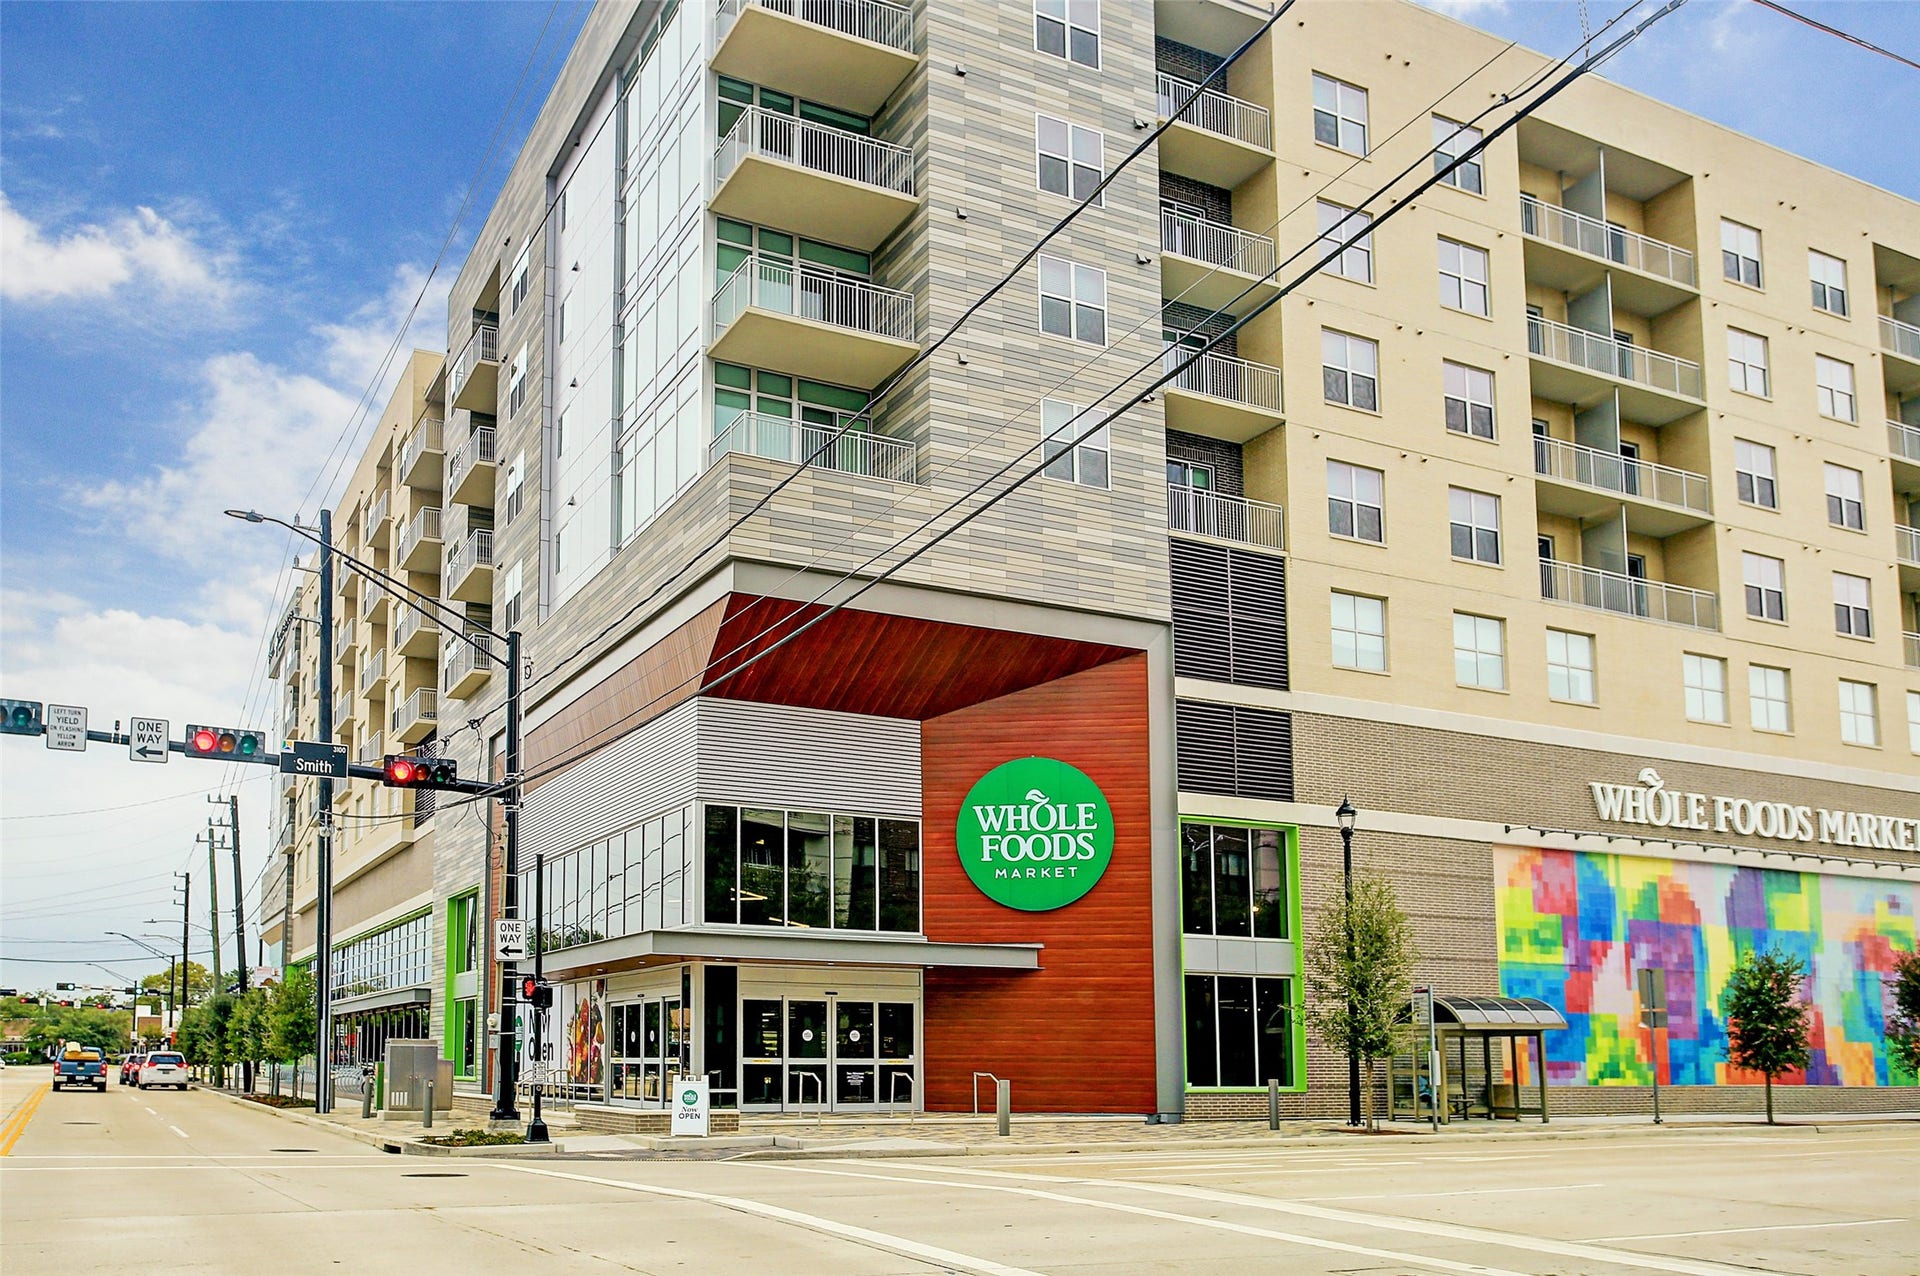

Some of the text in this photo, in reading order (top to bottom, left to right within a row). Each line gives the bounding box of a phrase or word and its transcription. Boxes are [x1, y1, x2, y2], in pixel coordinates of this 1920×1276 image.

[56, 716, 79, 725] YIELD
[137, 721, 163, 733] ONE
[136, 733, 163, 745] WAY
[333, 746, 347, 754] 3100
[295, 757, 332, 774] Smith
[972, 788, 1098, 833] WHOLE
[1589, 767, 1709, 831] WHOLE
[1713, 795, 1815, 843] FOODS
[980, 832, 1096, 862] FOODS
[994, 866, 1078, 880] MARKET
[499, 922, 522, 933] ONE
[499, 933, 522, 944] WAY
[528, 1036, 554, 1062] Oen
[678, 1112, 701, 1120] OPEN
